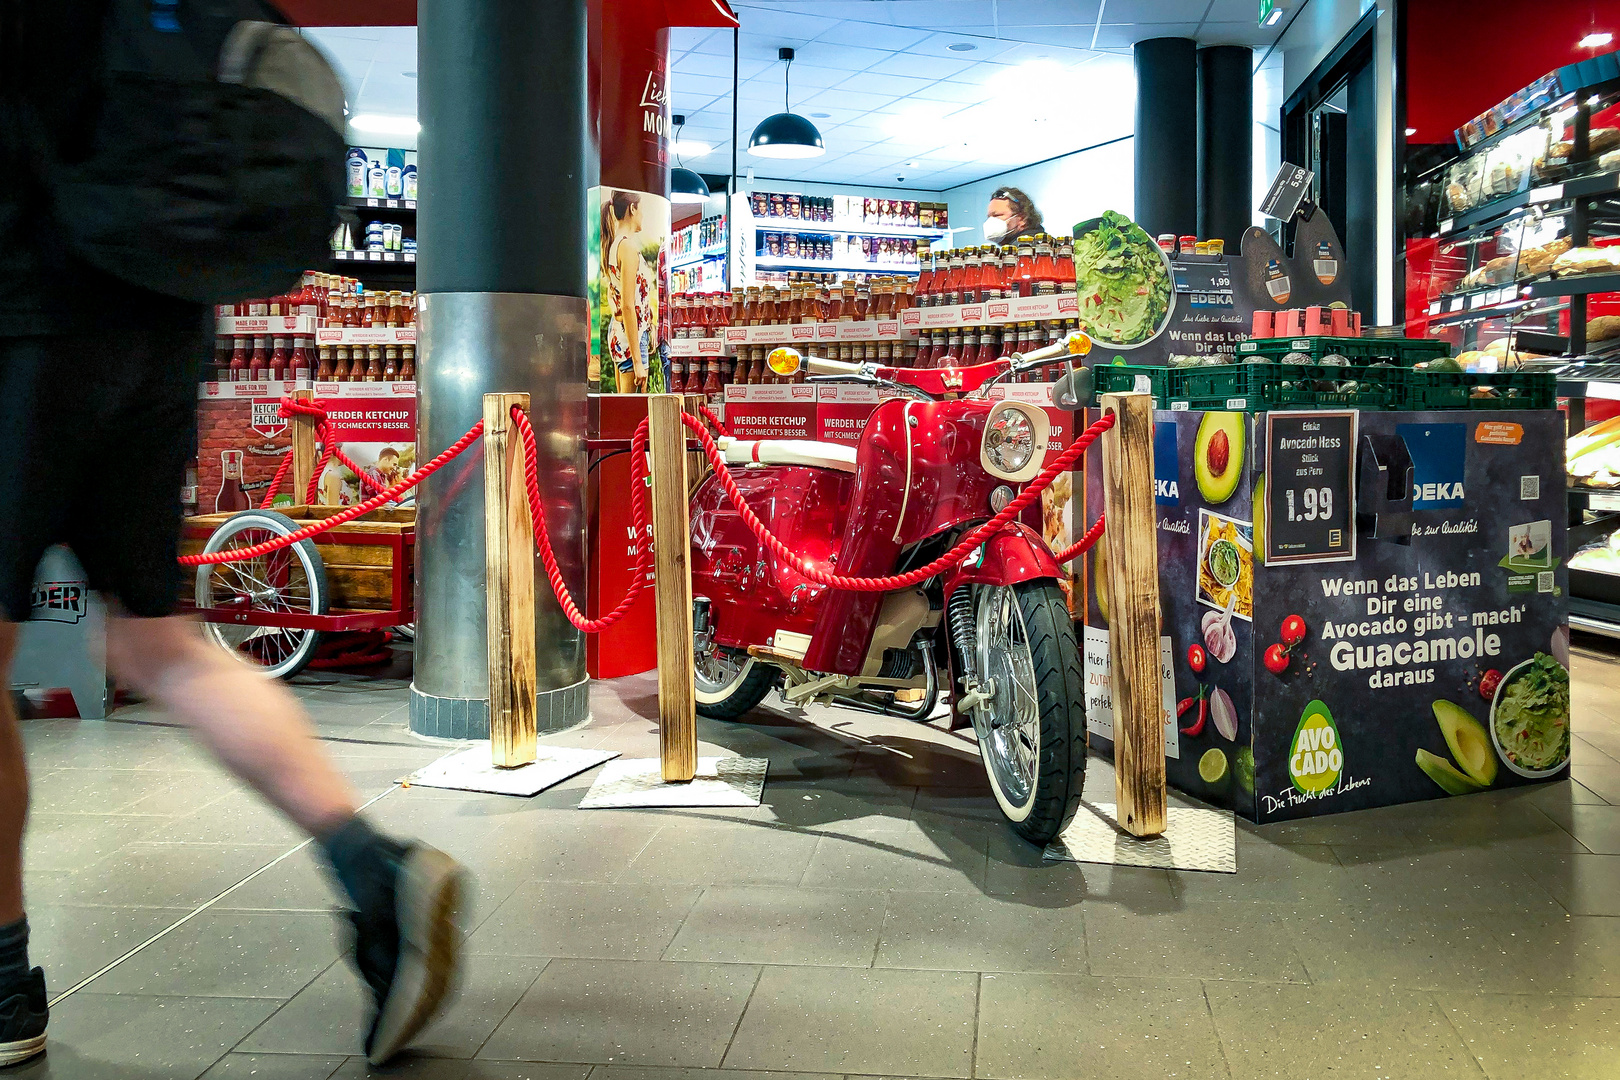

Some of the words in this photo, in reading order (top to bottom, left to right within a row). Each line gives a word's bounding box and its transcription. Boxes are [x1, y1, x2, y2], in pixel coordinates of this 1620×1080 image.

[1291, 170, 1306, 188] 5,99
[1210, 277, 1230, 287] 1,99
[1059, 299, 1077, 308] WERDE
[1190, 294, 1234, 304] EDEKA
[1169, 331, 1203, 341] Wenn
[1205, 331, 1225, 342] das
[1196, 342, 1212, 352] Dir
[254, 404, 281, 413] KETCHU
[366, 411, 409, 419] KETCHUP
[734, 416, 768, 425] WERDER
[770, 417, 806, 426] KETCHUP
[824, 419, 854, 428] WERDER
[1303, 422, 1320, 430] Edeka
[1280, 438, 1317, 450] Avocado
[1319, 436, 1341, 448] Hass
[1302, 454, 1319, 463] Stück
[1309, 466, 1323, 476] Peru
[1414, 482, 1465, 501] DEKA
[1286, 487, 1333, 521] 1.99
[1424, 526, 1440, 535] zur
[1442, 519, 1478, 534] Qualität.
[1322, 578, 1378, 598] Wenn
[1385, 575, 1418, 593] das
[1425, 571, 1480, 590] Leben
[1367, 598, 1397, 615] Dir
[1404, 595, 1442, 612] eine
[1322, 617, 1407, 640] Avocado
[1414, 613, 1453, 637] gibt
[1330, 628, 1501, 672] Guacamole
[1088, 652, 1104, 665] Hier
[1369, 668, 1435, 689] daraus
[1298, 726, 1335, 750] AVO
[1290, 748, 1342, 777] CADO
[1262, 796, 1285, 814] Die
[1280, 786, 1316, 806] Frucht
[1337, 770, 1371, 794] Lebens
